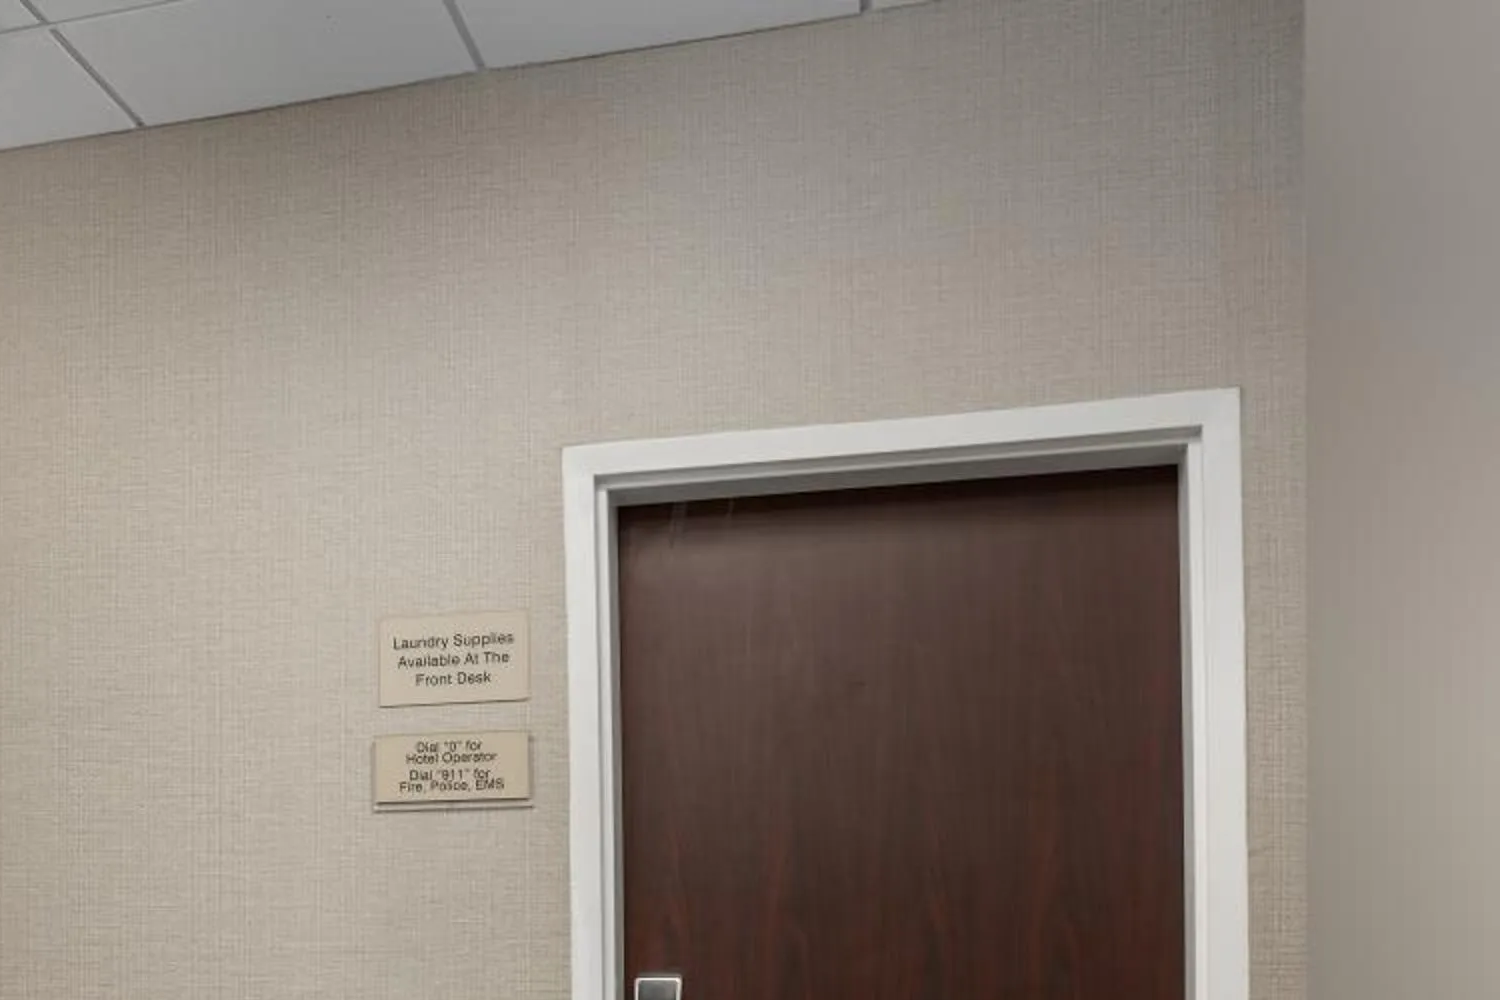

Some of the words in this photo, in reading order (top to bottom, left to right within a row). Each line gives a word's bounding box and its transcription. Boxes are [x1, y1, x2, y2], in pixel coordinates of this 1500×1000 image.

[393, 636, 449, 650] Laundry
[453, 632, 514, 648] Supplies
[398, 654, 460, 669] Available
[464, 653, 479, 665] At
[484, 651, 510, 664] The
[415, 673, 453, 686] Front
[457, 671, 491, 685] Desk
[416, 741, 438, 753] Dial
[465, 740, 482, 751] for
[406, 753, 439, 765] Hotel
[442, 752, 497, 765] Operator
[409, 769, 433, 781] Dial
[474, 767, 490, 779] for
[475, 778, 505, 790] EMS
